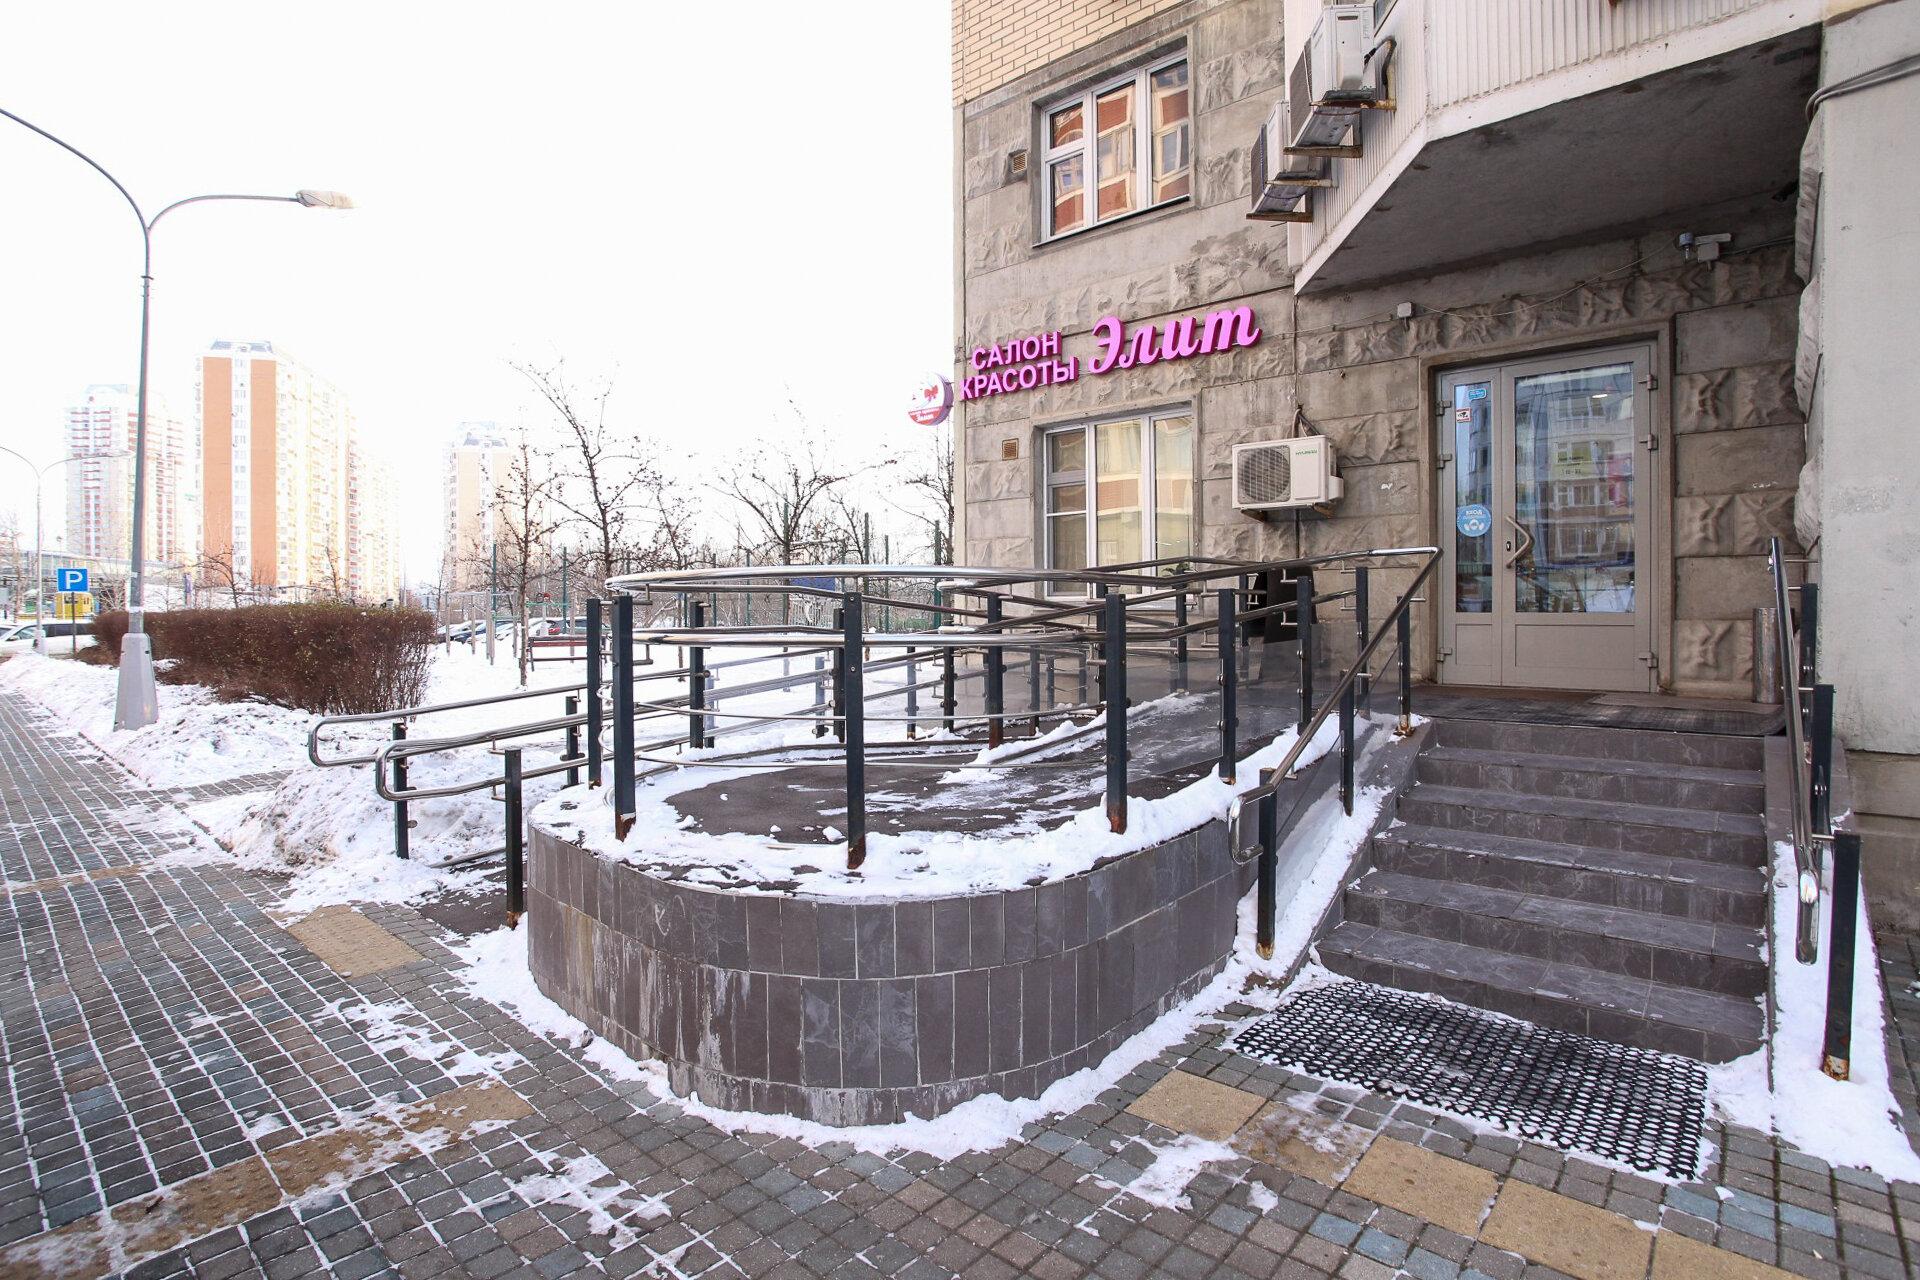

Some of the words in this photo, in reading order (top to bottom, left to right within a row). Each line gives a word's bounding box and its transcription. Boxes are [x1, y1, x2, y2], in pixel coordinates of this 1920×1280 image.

[971, 331, 1063, 371] САЛОН
[1088, 305, 1263, 375] Элит
[958, 357, 1079, 402] КРАСОТЫ
[65, 571, 83, 589] P
